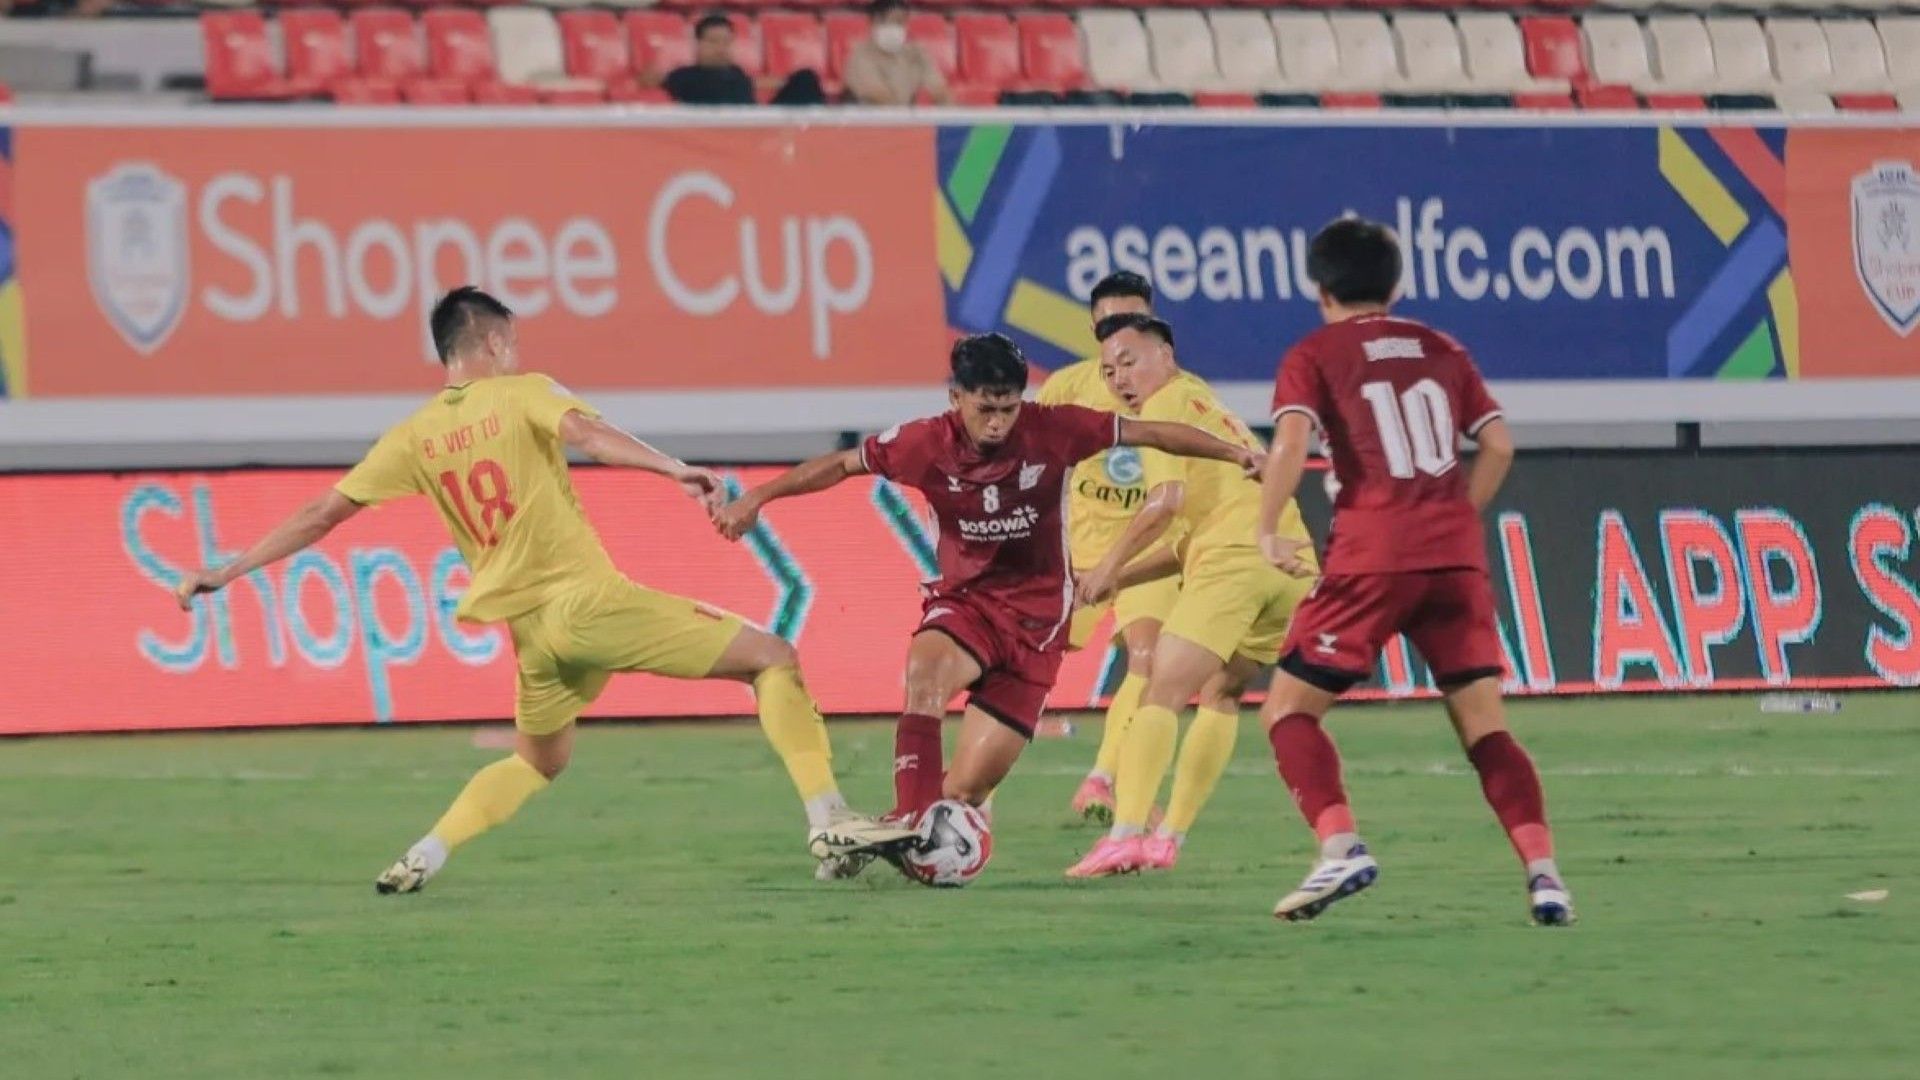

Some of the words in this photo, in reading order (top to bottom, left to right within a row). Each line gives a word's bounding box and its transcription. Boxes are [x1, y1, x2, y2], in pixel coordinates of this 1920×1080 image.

[201, 172, 618, 364] Shopee
[647, 172, 874, 359] Cup
[1361, 378, 1458, 479] 10
[440, 459, 517, 547] 18
[982, 484, 1000, 514] 8
[1595, 509, 1822, 688] APP
[1848, 503, 1920, 686] S
